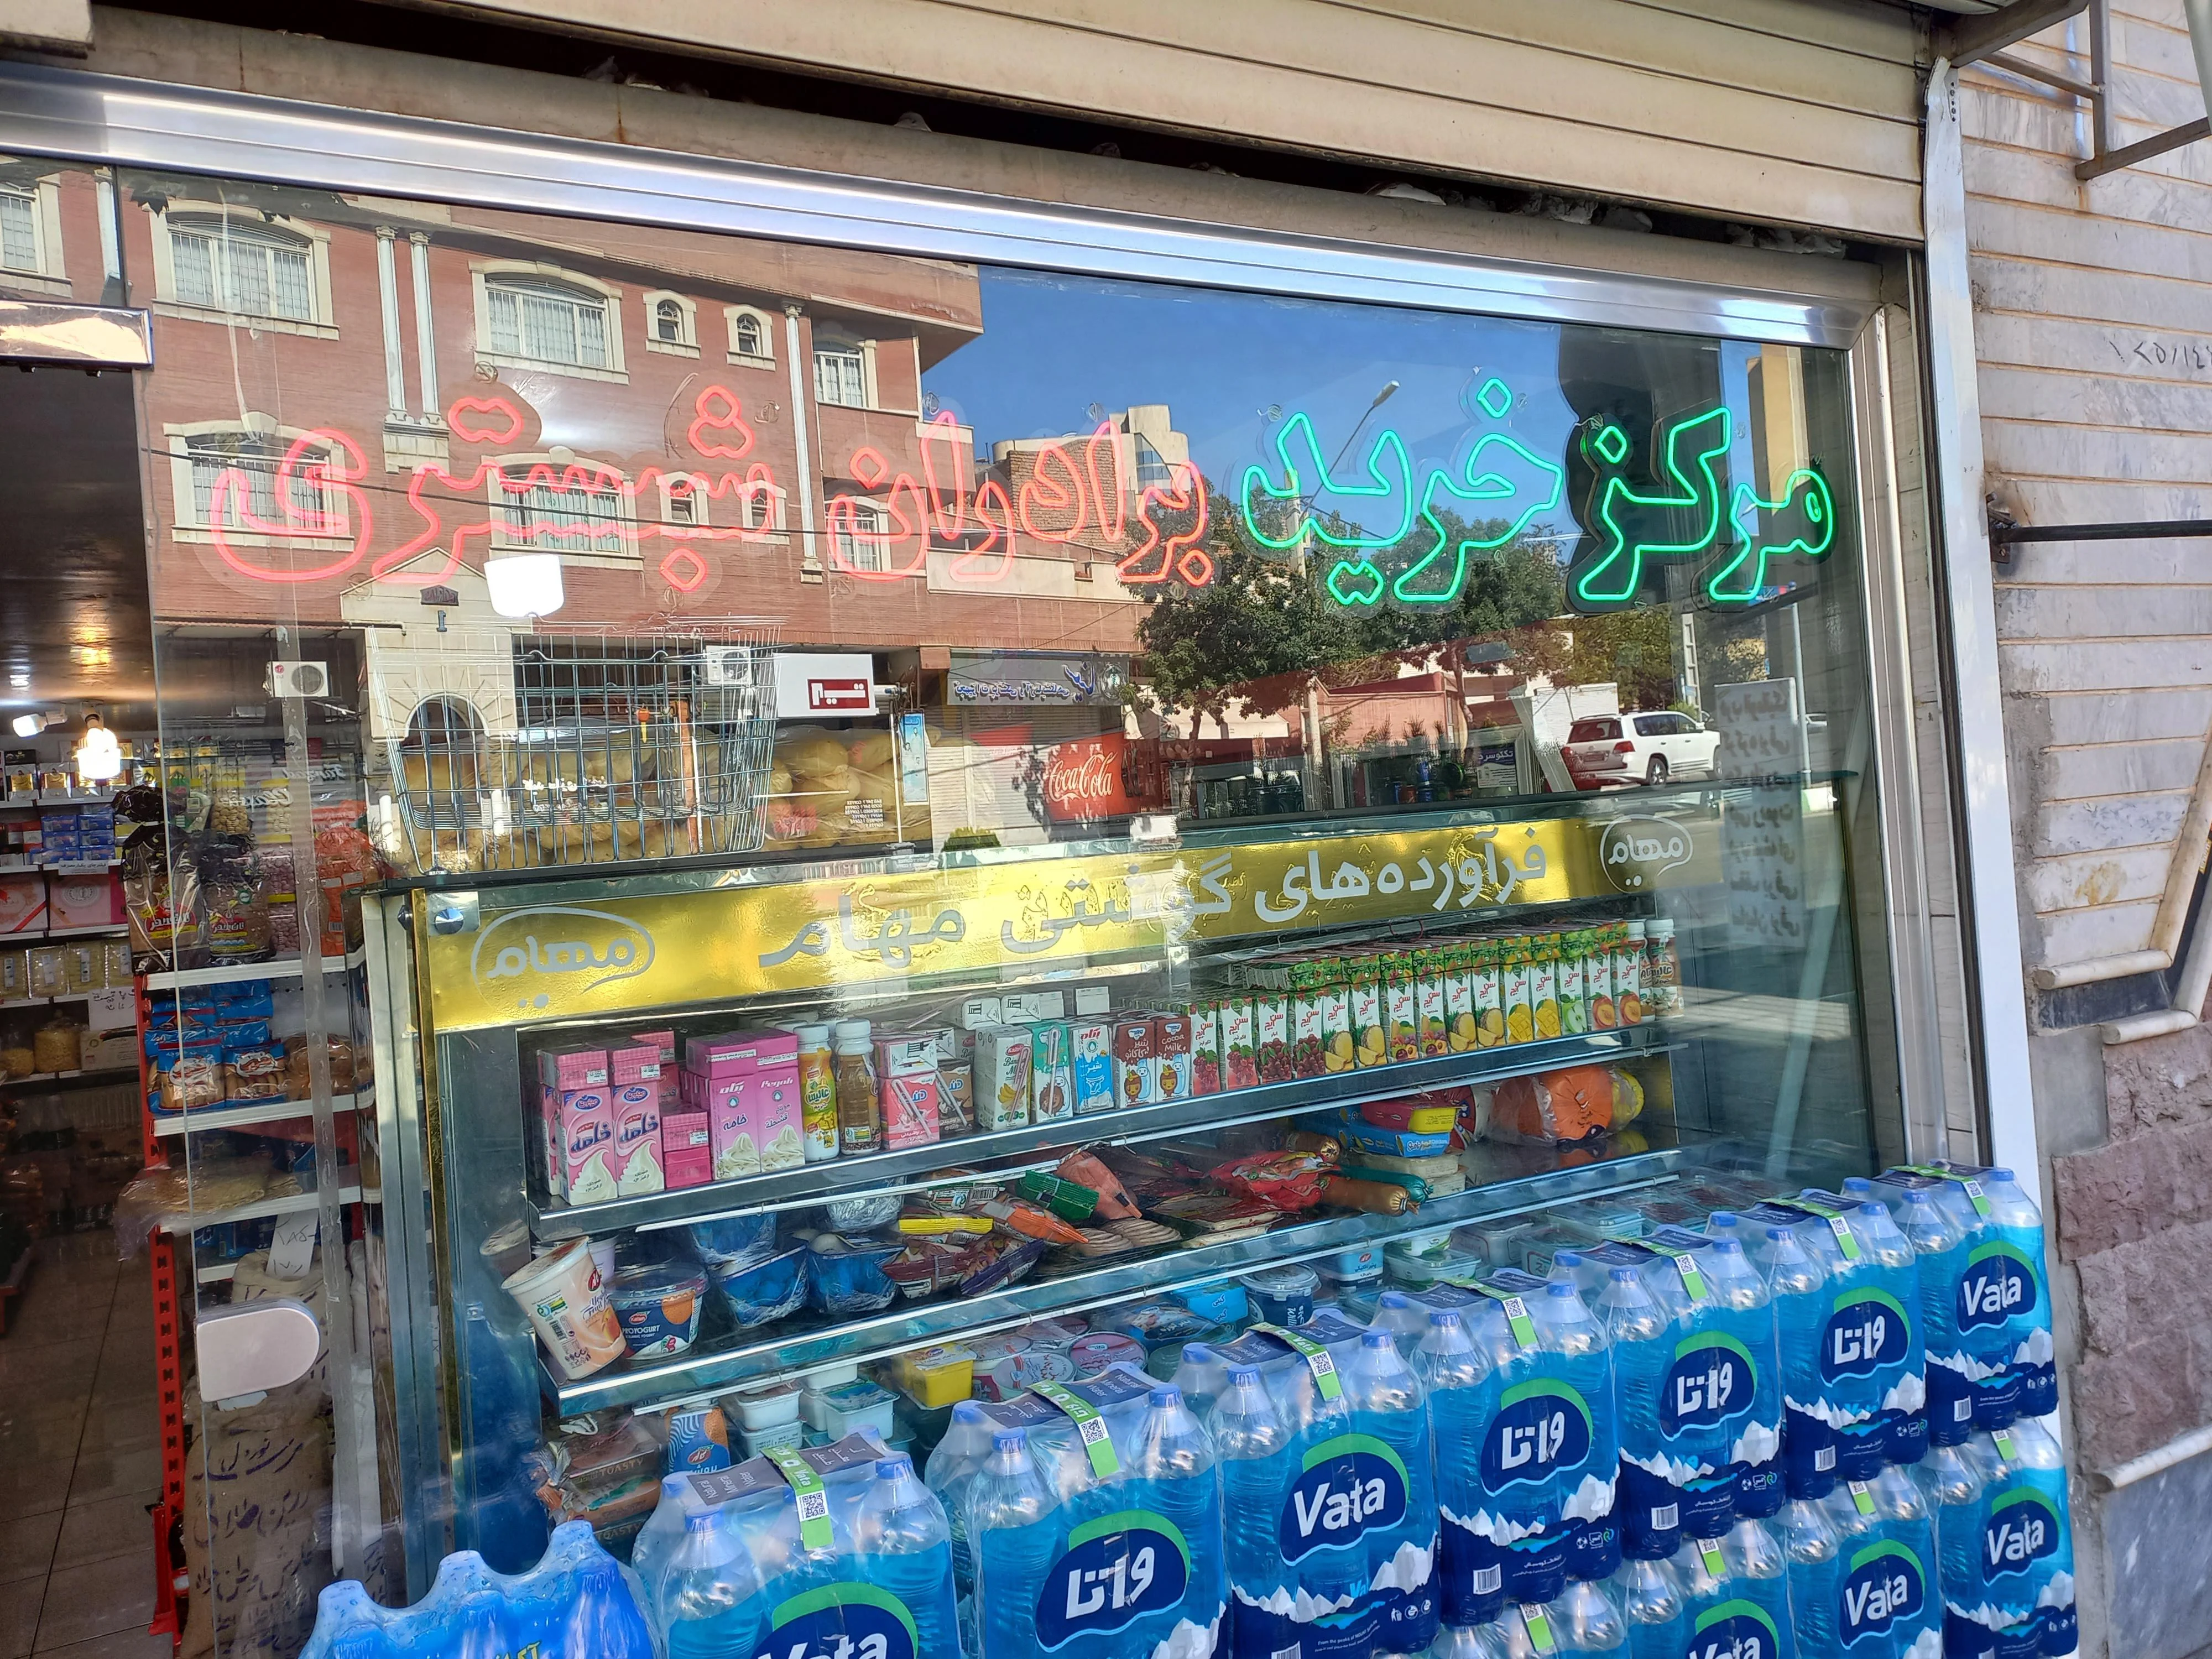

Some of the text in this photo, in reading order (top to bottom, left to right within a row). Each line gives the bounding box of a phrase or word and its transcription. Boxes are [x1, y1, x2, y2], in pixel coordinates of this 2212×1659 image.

[210, 384, 1215, 601] برادران شبستری
[1240, 377, 1835, 606] مرکز خرید
[1081, 1027, 1101, 1040] پگاه
[1087, 1061, 1102, 1073] شیر
[719, 1081, 744, 1094] پگاه
[760, 1077, 793, 1088] Pegah
[807, 1088, 830, 1103] عالیس
[571, 1122, 611, 1153] خامه
[619, 1113, 658, 1143] خامه
[723, 1114, 748, 1131] خامه
[1963, 1274, 2022, 1317] Vata
[1291, 1336, 1314, 1352] Vata
[1833, 1314, 1885, 1365] واتا
[1087, 1383, 1107, 1397] Water
[1115, 1373, 1142, 1389] Natural
[1676, 1361, 1733, 1417] واتا
[1501, 1411, 1565, 1470] واتا
[600, 1458, 644, 1478] TOASTY
[794, 1468, 811, 1487] Vata
[697, 1470, 758, 1500] Natural Mineral Water
[1293, 1477, 1386, 1538] Vata
[1987, 1519, 2044, 1566] Vata
[1065, 1546, 1155, 1620] واتا
[1845, 1573, 1908, 1627] Vata
